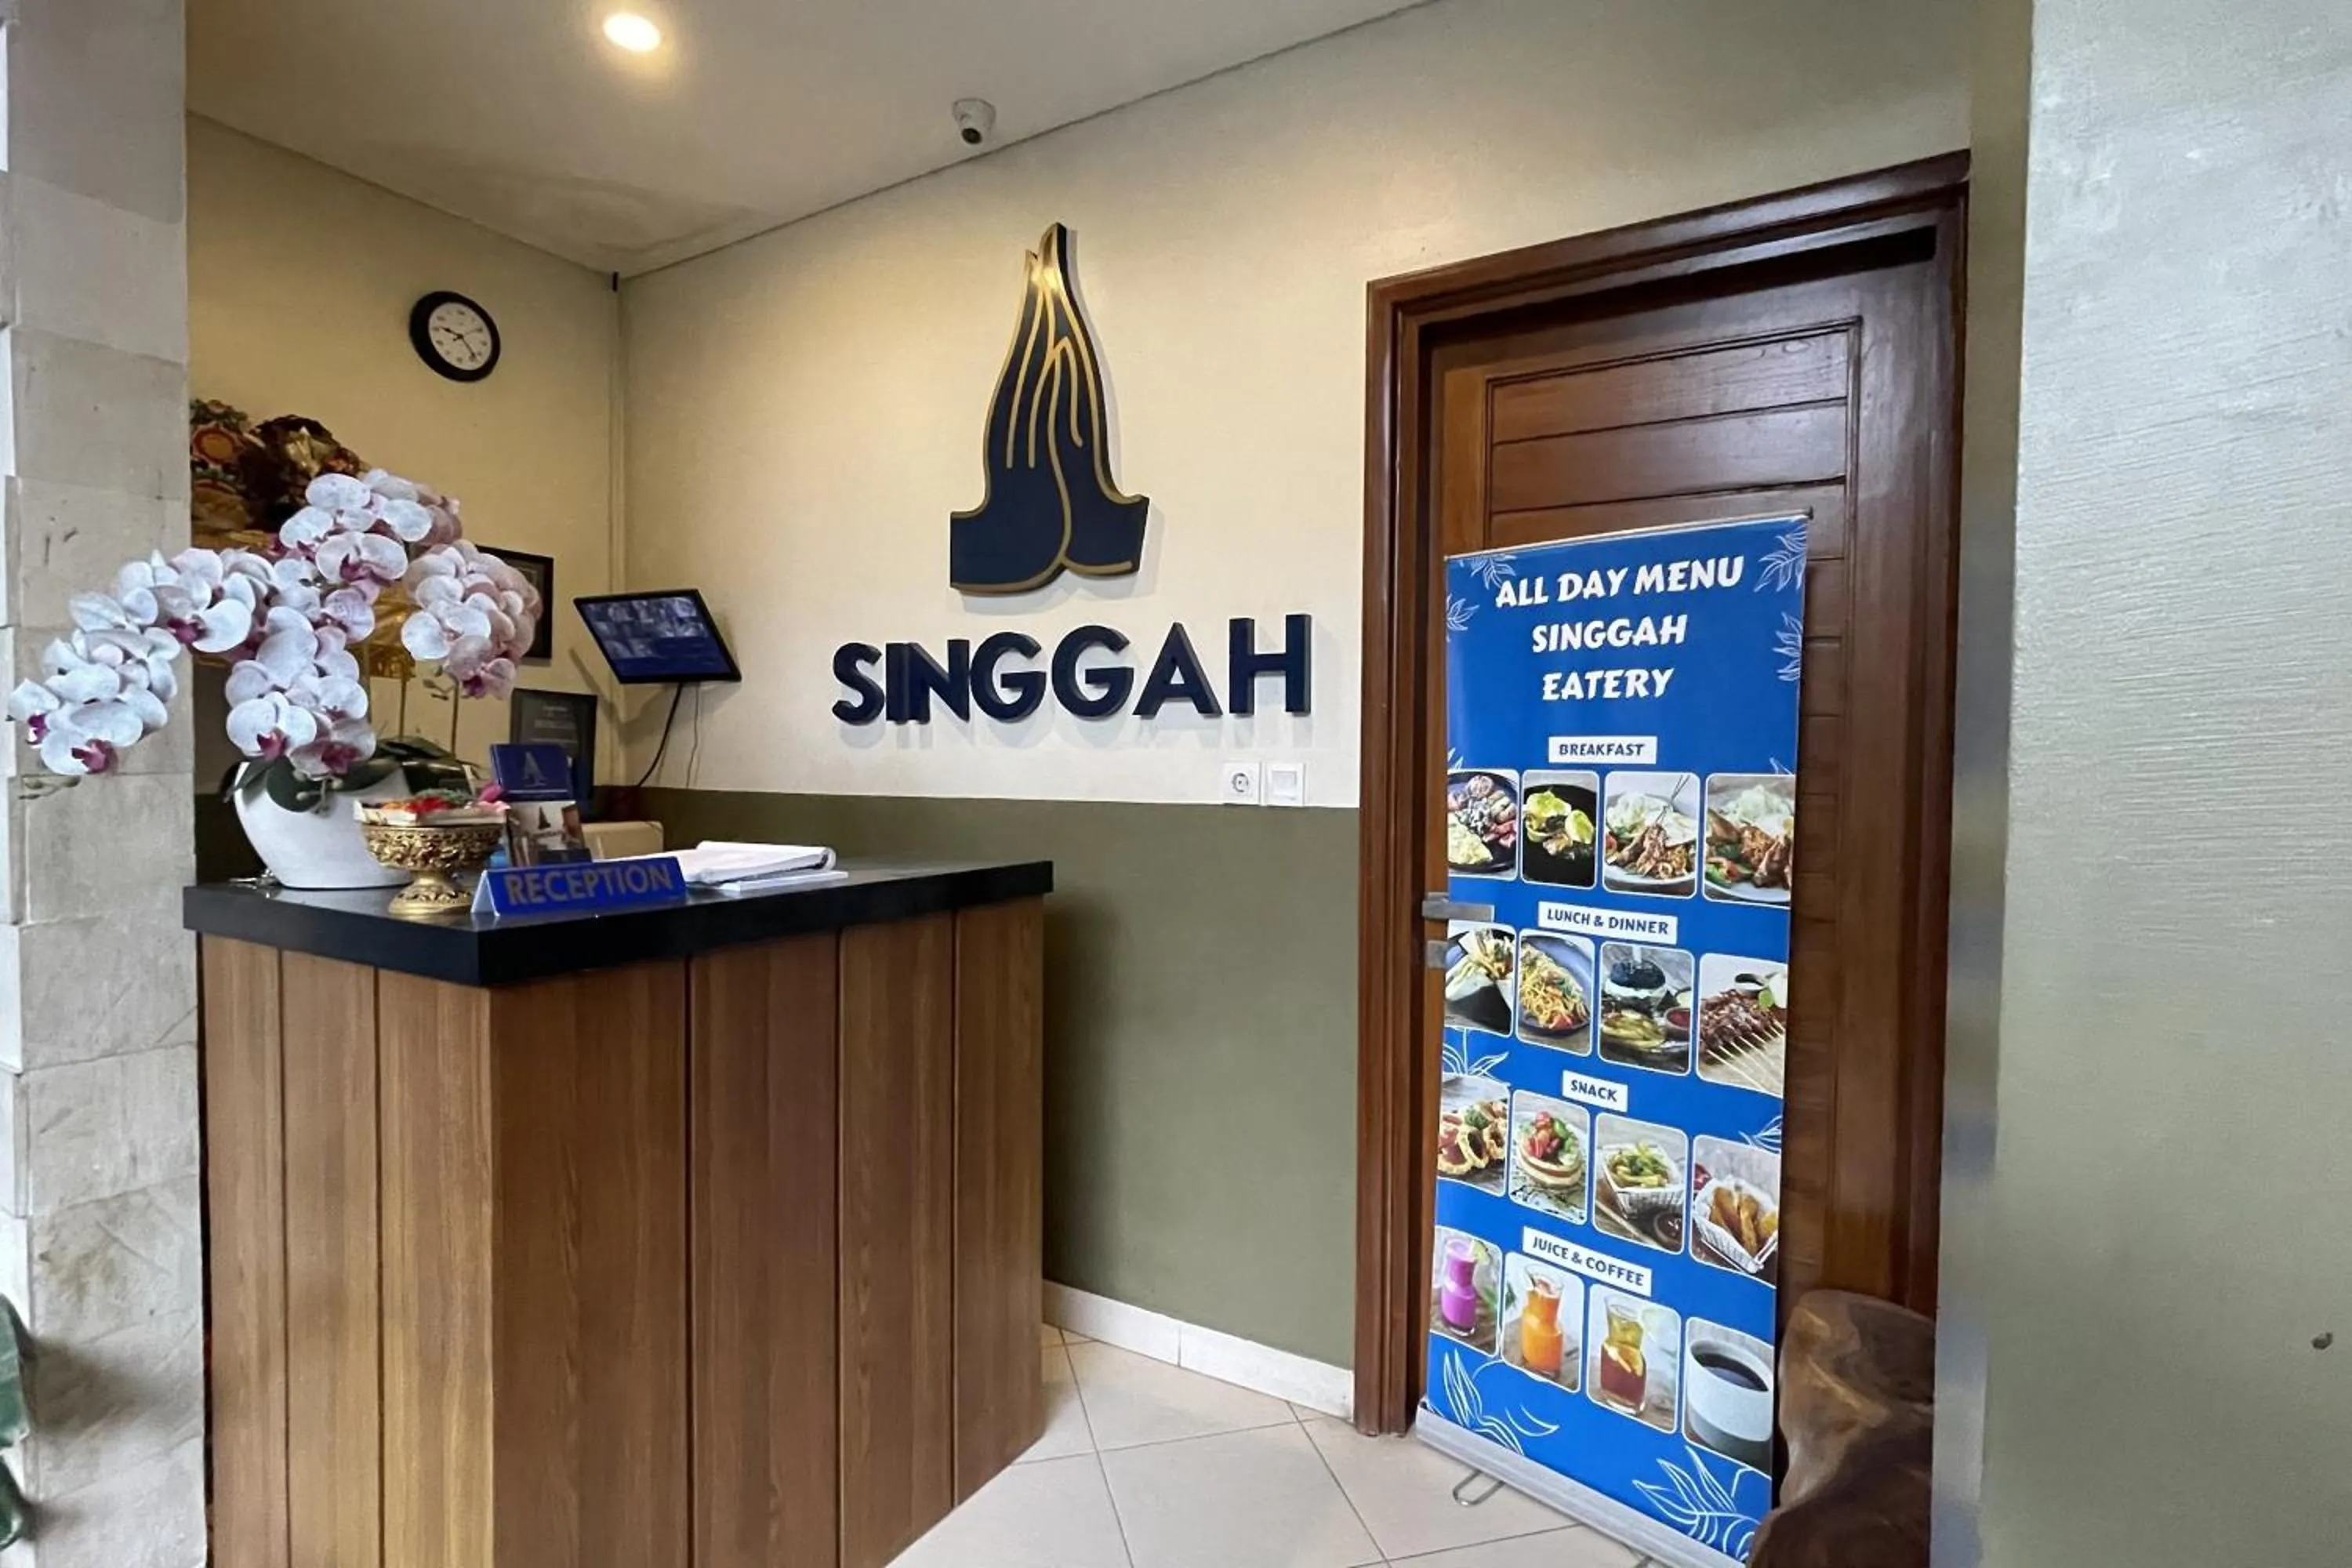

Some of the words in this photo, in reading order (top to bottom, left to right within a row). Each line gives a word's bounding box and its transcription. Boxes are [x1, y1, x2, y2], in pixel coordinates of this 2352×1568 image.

[1495, 576, 1549, 608] ALL
[1557, 567, 1629, 603] DAY
[1633, 555, 1745, 595] MENU
[1532, 614, 1688, 653] SINGGAH
[832, 614, 1312, 725] SINGGAH
[1542, 667, 1675, 700] EATERY
[1559, 743, 1646, 757] BREAKFAST
[503, 863, 676, 906] RECEPTION
[1547, 908, 1591, 926] LUNCH
[1593, 915, 1604, 927] &
[1608, 916, 1669, 935] DINNER
[1570, 1080, 1618, 1102] SNACK
[1533, 1236, 1569, 1260] JUICE
[1571, 1251, 1583, 1265] &
[1585, 1257, 1645, 1287] COFFEE
